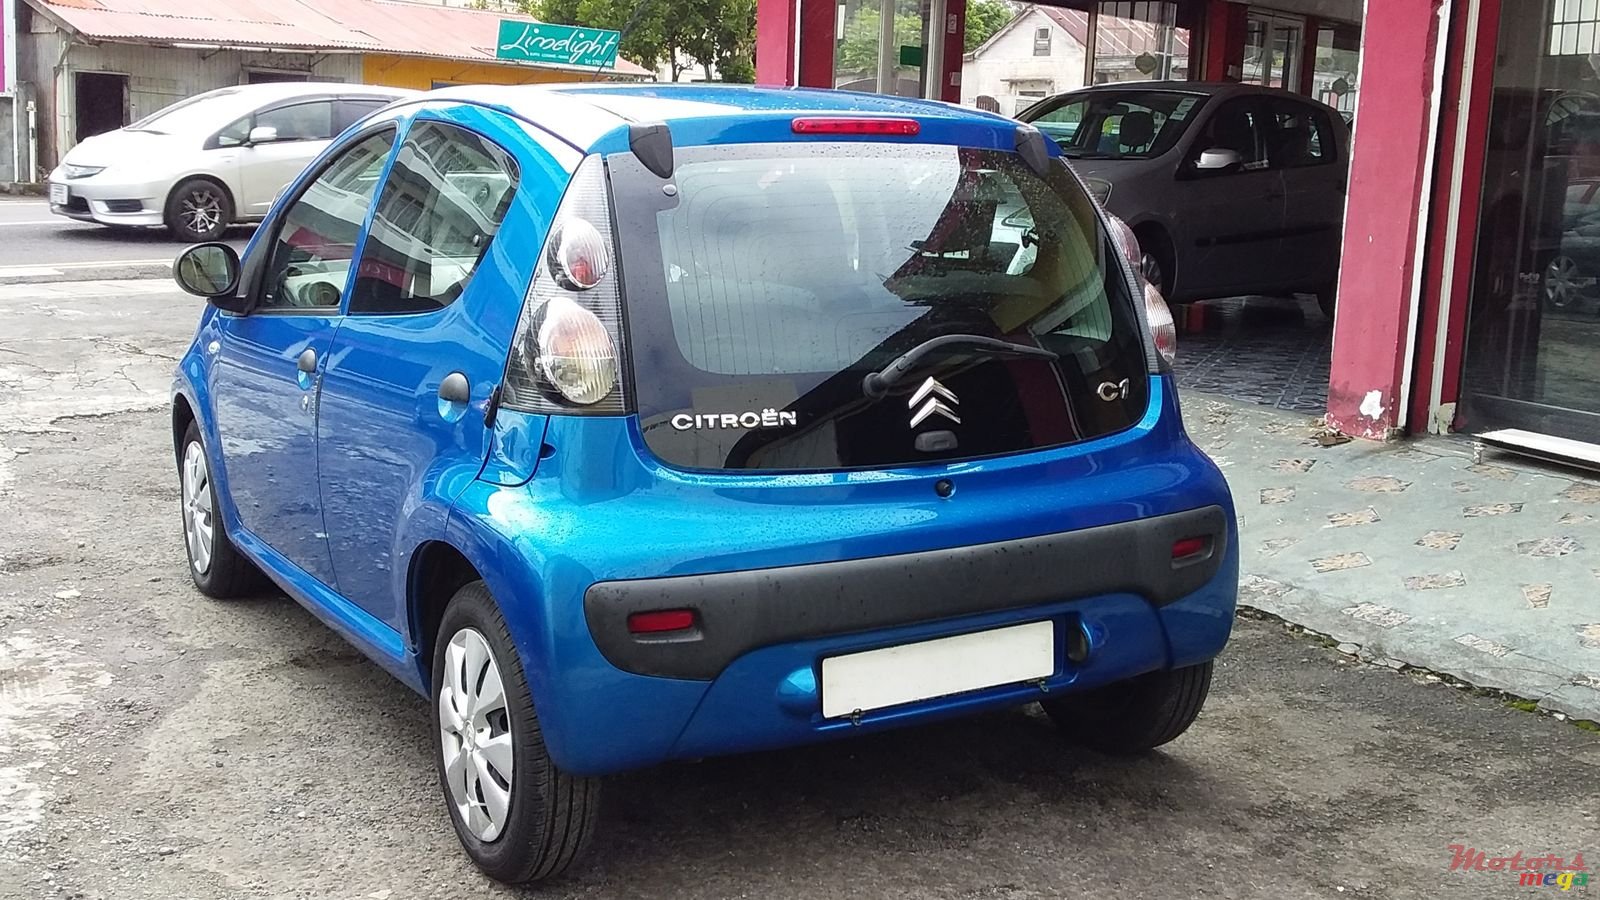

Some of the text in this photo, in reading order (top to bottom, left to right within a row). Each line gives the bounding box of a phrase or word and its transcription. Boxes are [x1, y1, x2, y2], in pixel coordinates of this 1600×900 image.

[500, 24, 617, 63] Limelight
[1096, 377, 1129, 401] C1
[671, 408, 797, 430] CITROËN
